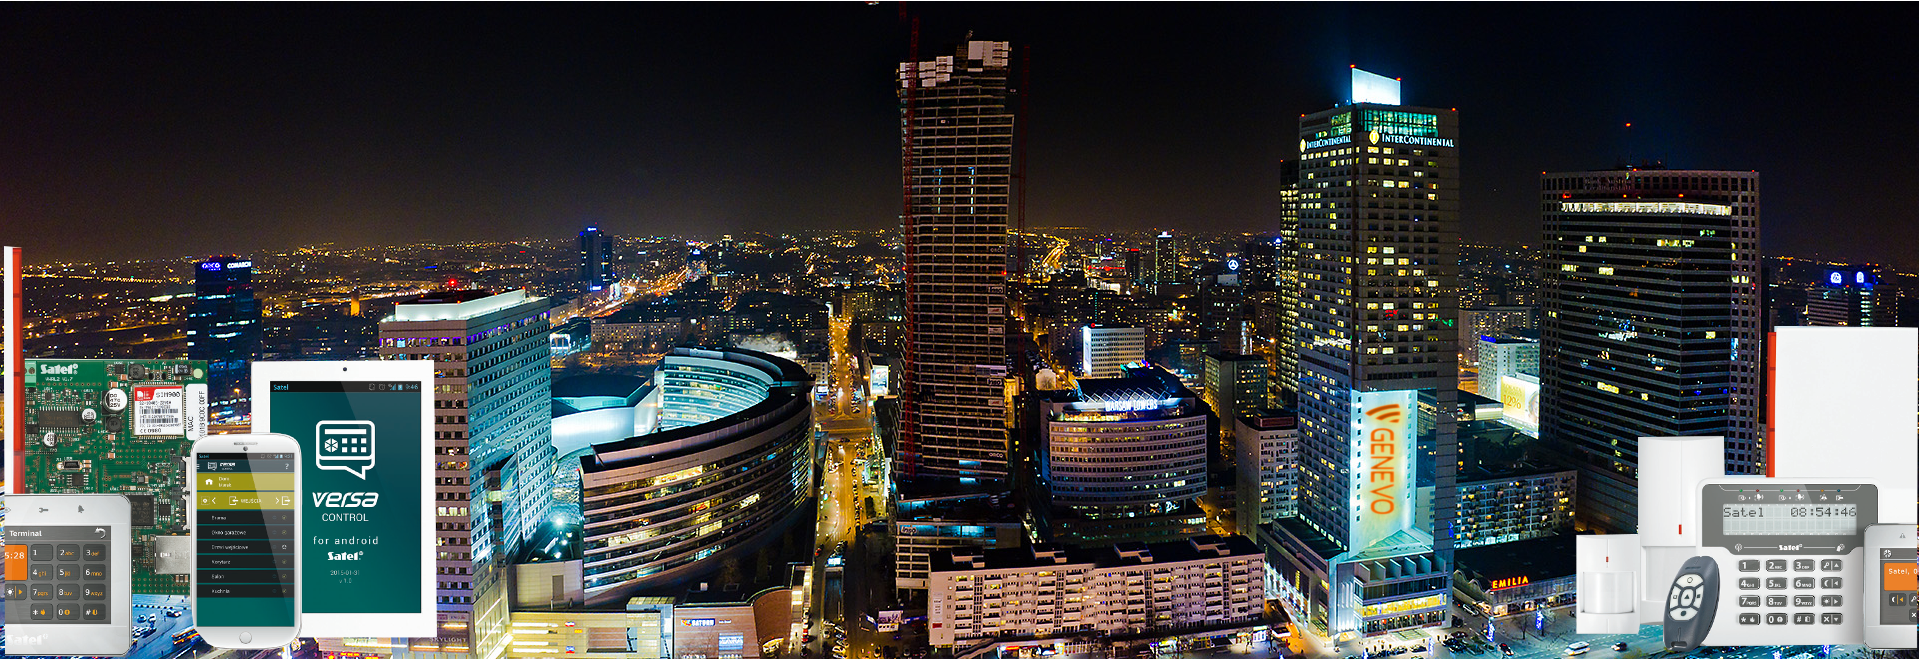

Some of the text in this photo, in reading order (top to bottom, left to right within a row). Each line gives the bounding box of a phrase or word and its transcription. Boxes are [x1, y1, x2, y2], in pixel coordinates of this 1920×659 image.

[1382, 134, 1455, 148] INTERCONTINENTAL
[1104, 400, 1132, 411] WARSAW
[1503, 394, 1522, 410] 12%
[1370, 427, 1395, 515] GENEVO
[322, 513, 369, 522] CONTROL
[1723, 507, 1857, 518] Satel 08:54:46
[313, 536, 379, 545] for android
[5, 552, 25, 560] 5:28
[1491, 575, 1529, 589] EMILIA
